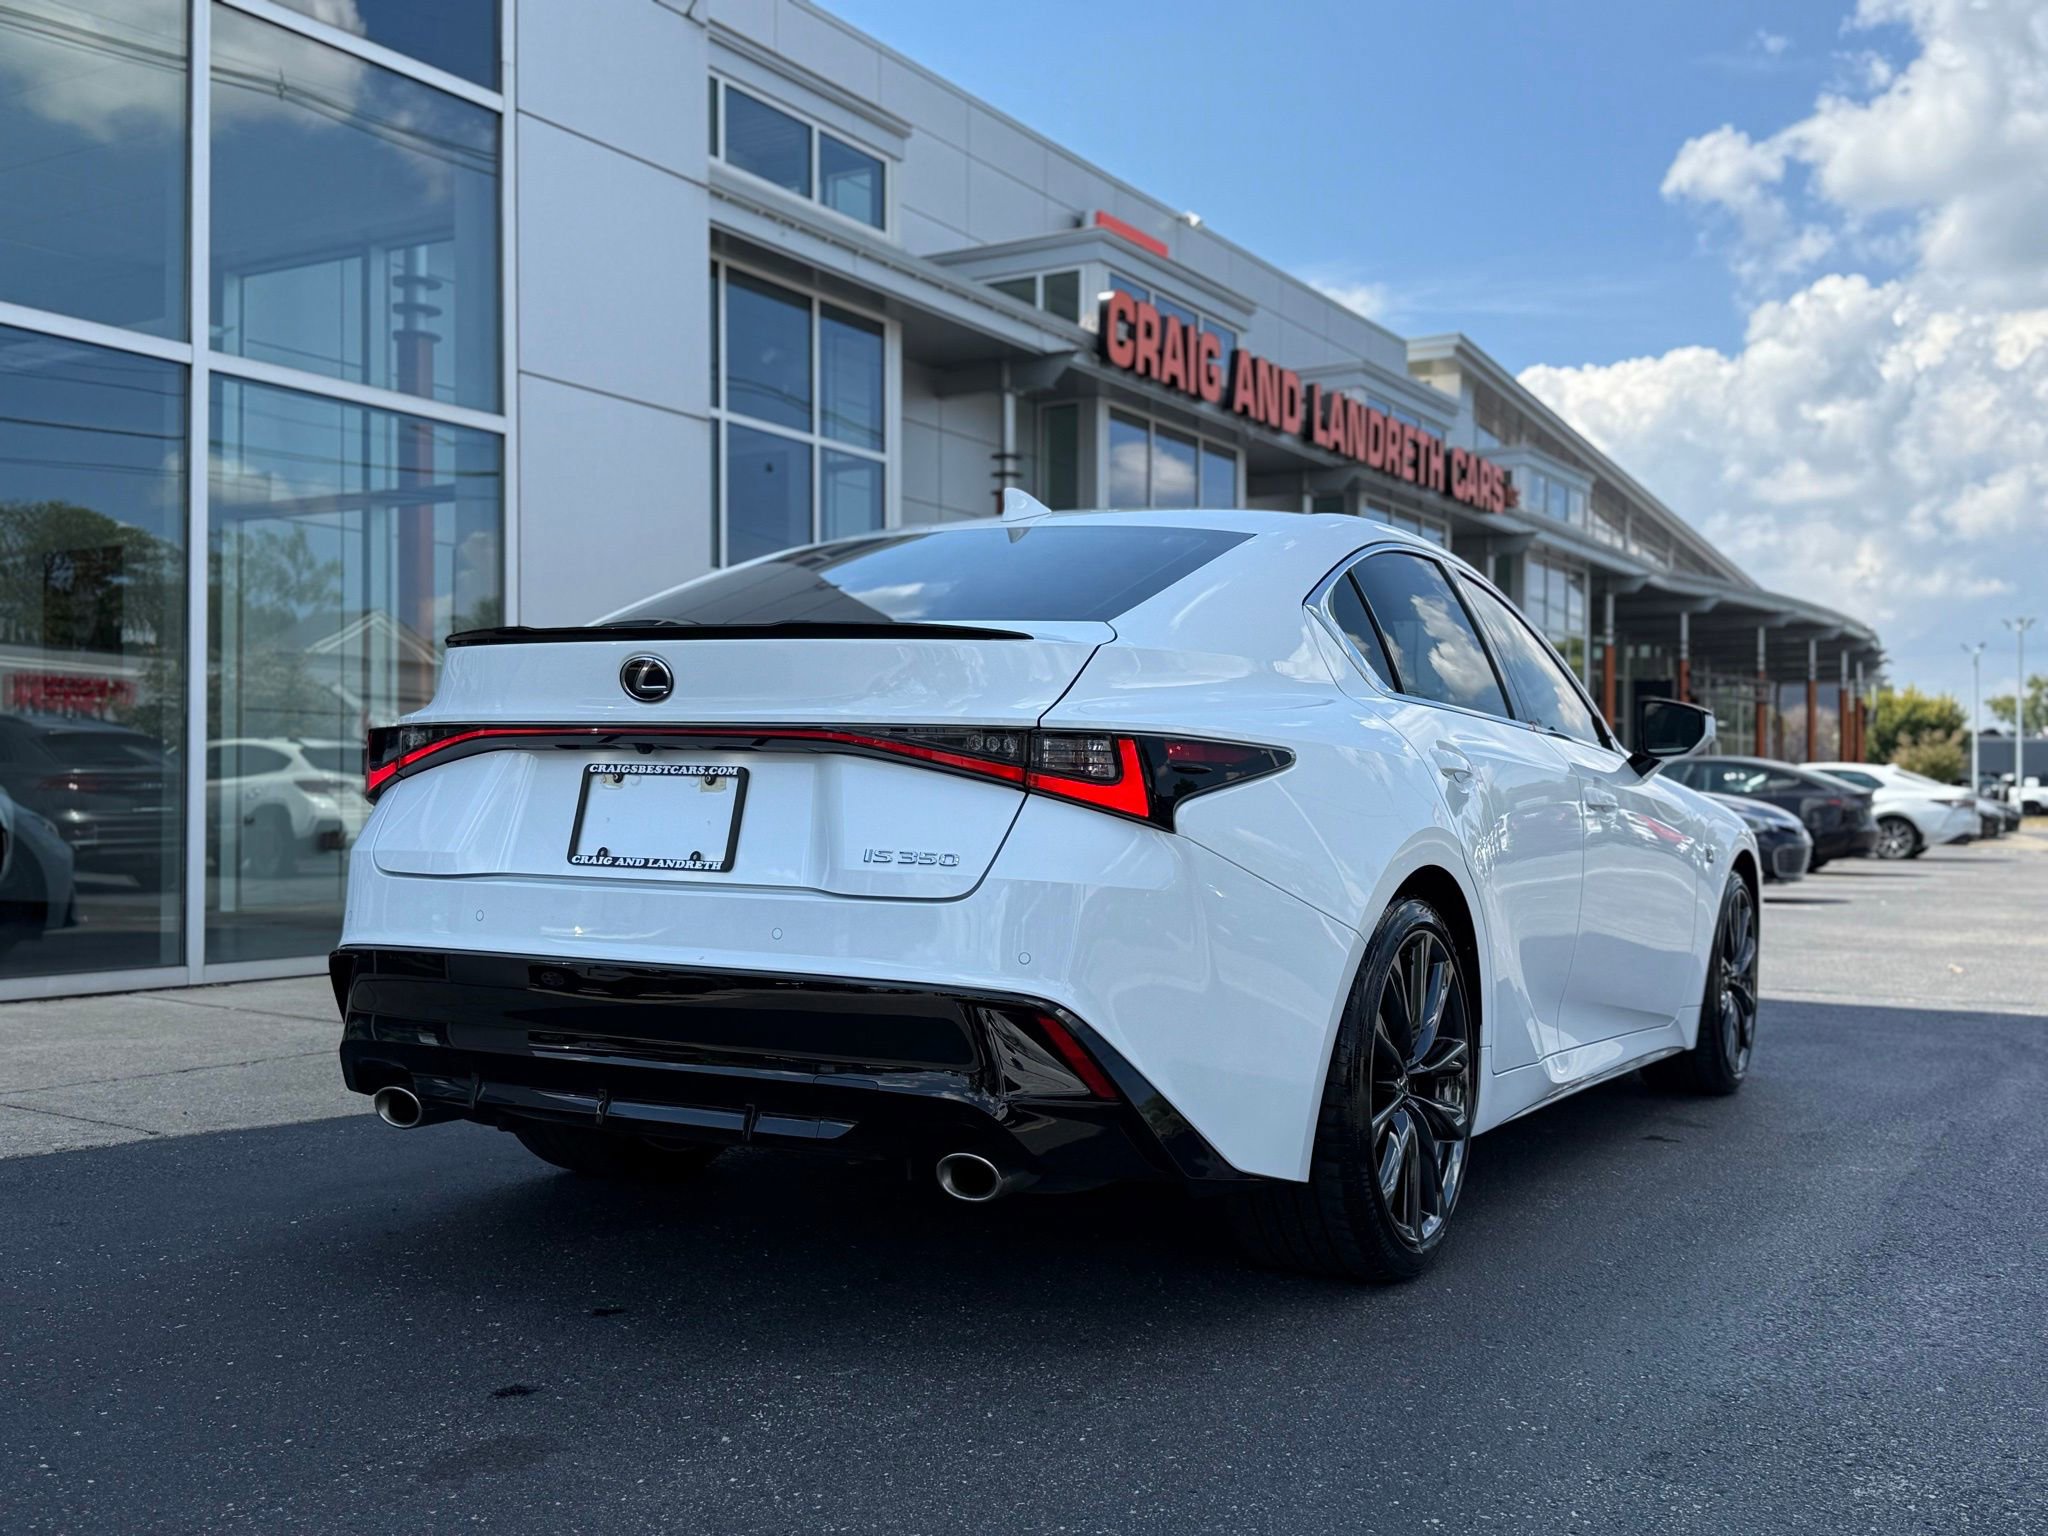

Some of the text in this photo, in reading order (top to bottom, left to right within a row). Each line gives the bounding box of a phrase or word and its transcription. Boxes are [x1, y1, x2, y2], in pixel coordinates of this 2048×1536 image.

[1106, 290, 1505, 514] CRAIG AND LANDRETH CARS
[589, 764, 738, 776] CRAIGSBESTCARS.COM
[571, 854, 723, 871] CRAIG AND LANDRETH
[863, 848, 960, 867] IS 350
